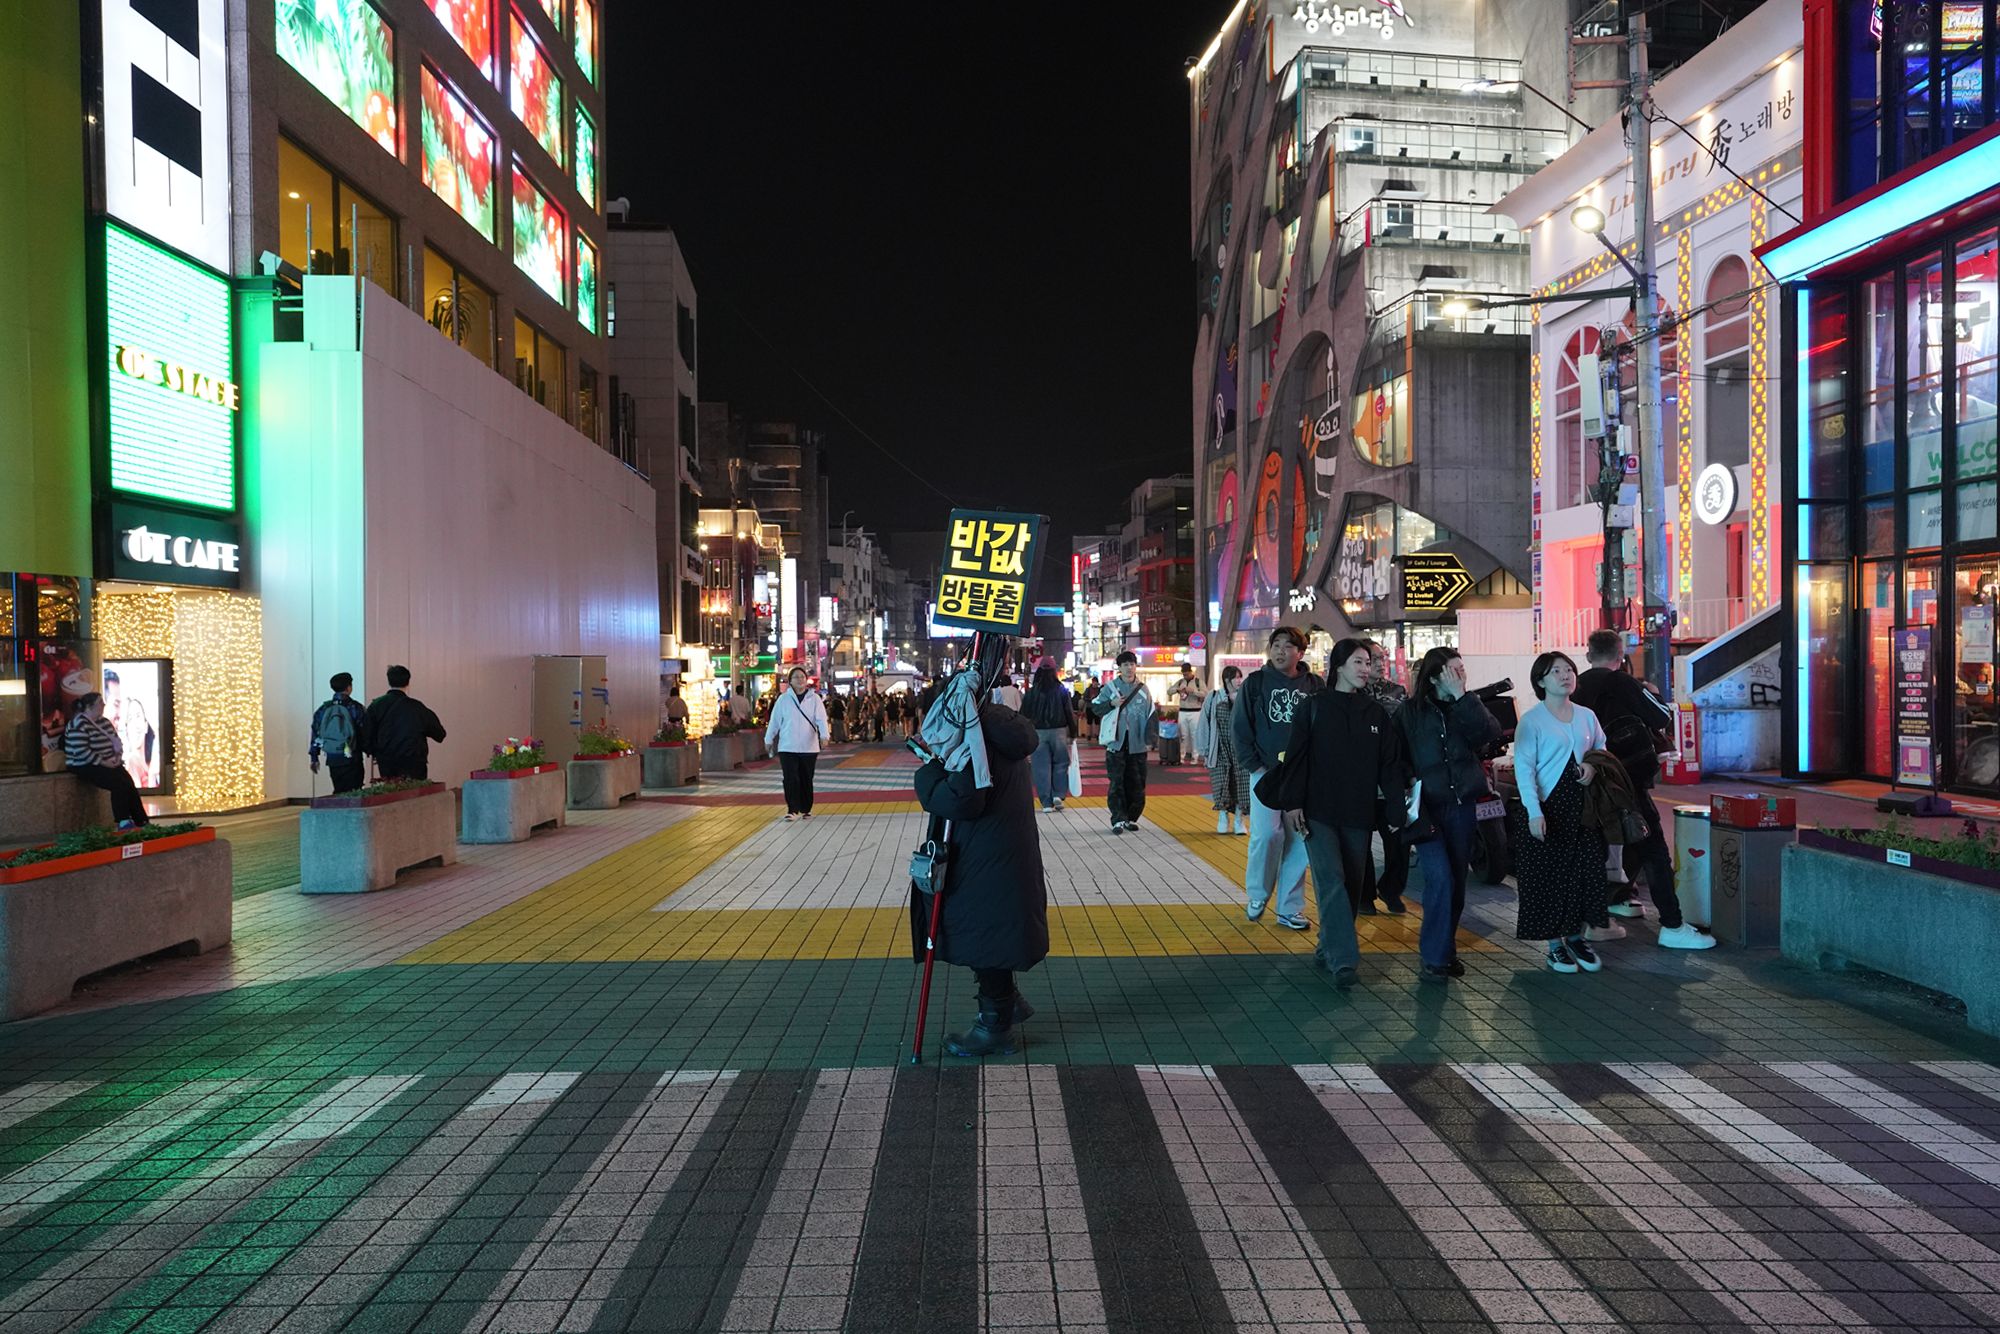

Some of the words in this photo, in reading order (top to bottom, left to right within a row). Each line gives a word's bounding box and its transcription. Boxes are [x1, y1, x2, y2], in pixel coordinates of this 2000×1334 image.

[1292, 2, 1394, 40] 상상마당
[1608, 152, 1698, 216] Luury
[1739, 90, 1795, 143] 노래방
[161, 361, 238, 411] STAGE
[1928, 438, 1998, 471] WLCO
[172, 537, 239, 572] CAFE
[950, 519, 1031, 575] 반값
[942, 579, 1019, 620] 방탈출
[1406, 579, 1443, 592] 상상마당
[1155, 653, 1174, 663] 코인
